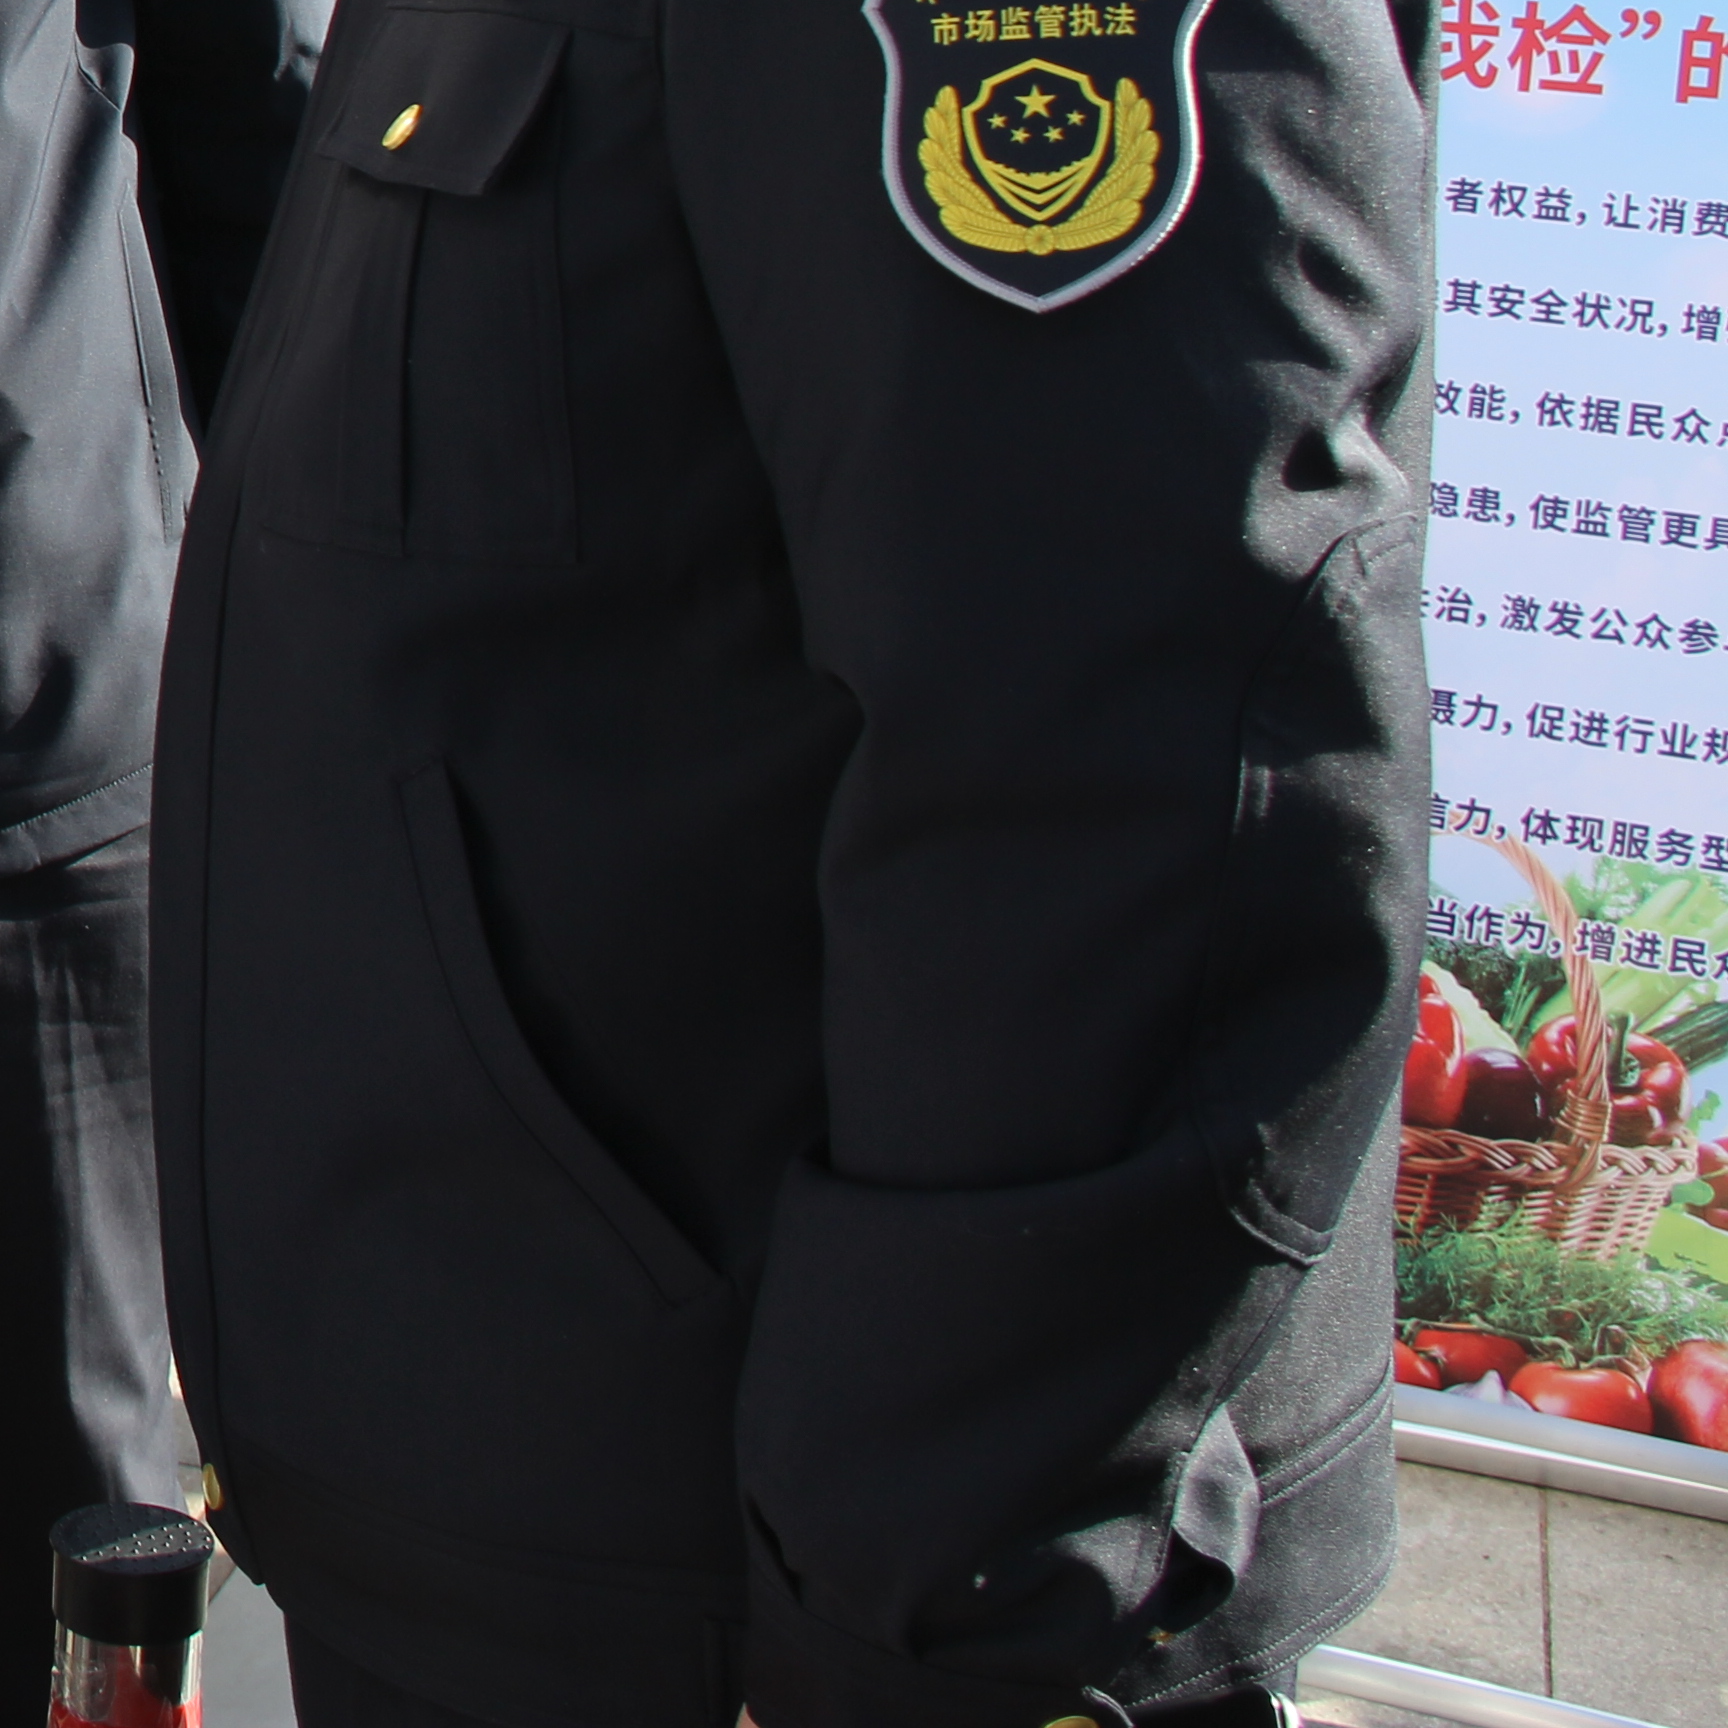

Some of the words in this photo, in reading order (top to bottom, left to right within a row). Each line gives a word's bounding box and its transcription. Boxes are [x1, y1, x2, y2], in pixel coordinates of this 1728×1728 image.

[930, 2, 1137, 46] 市场监管执法
[1434, 278, 1728, 342] 其安全状况，增
[1420, 584, 1728, 654] 治，激发公众参
